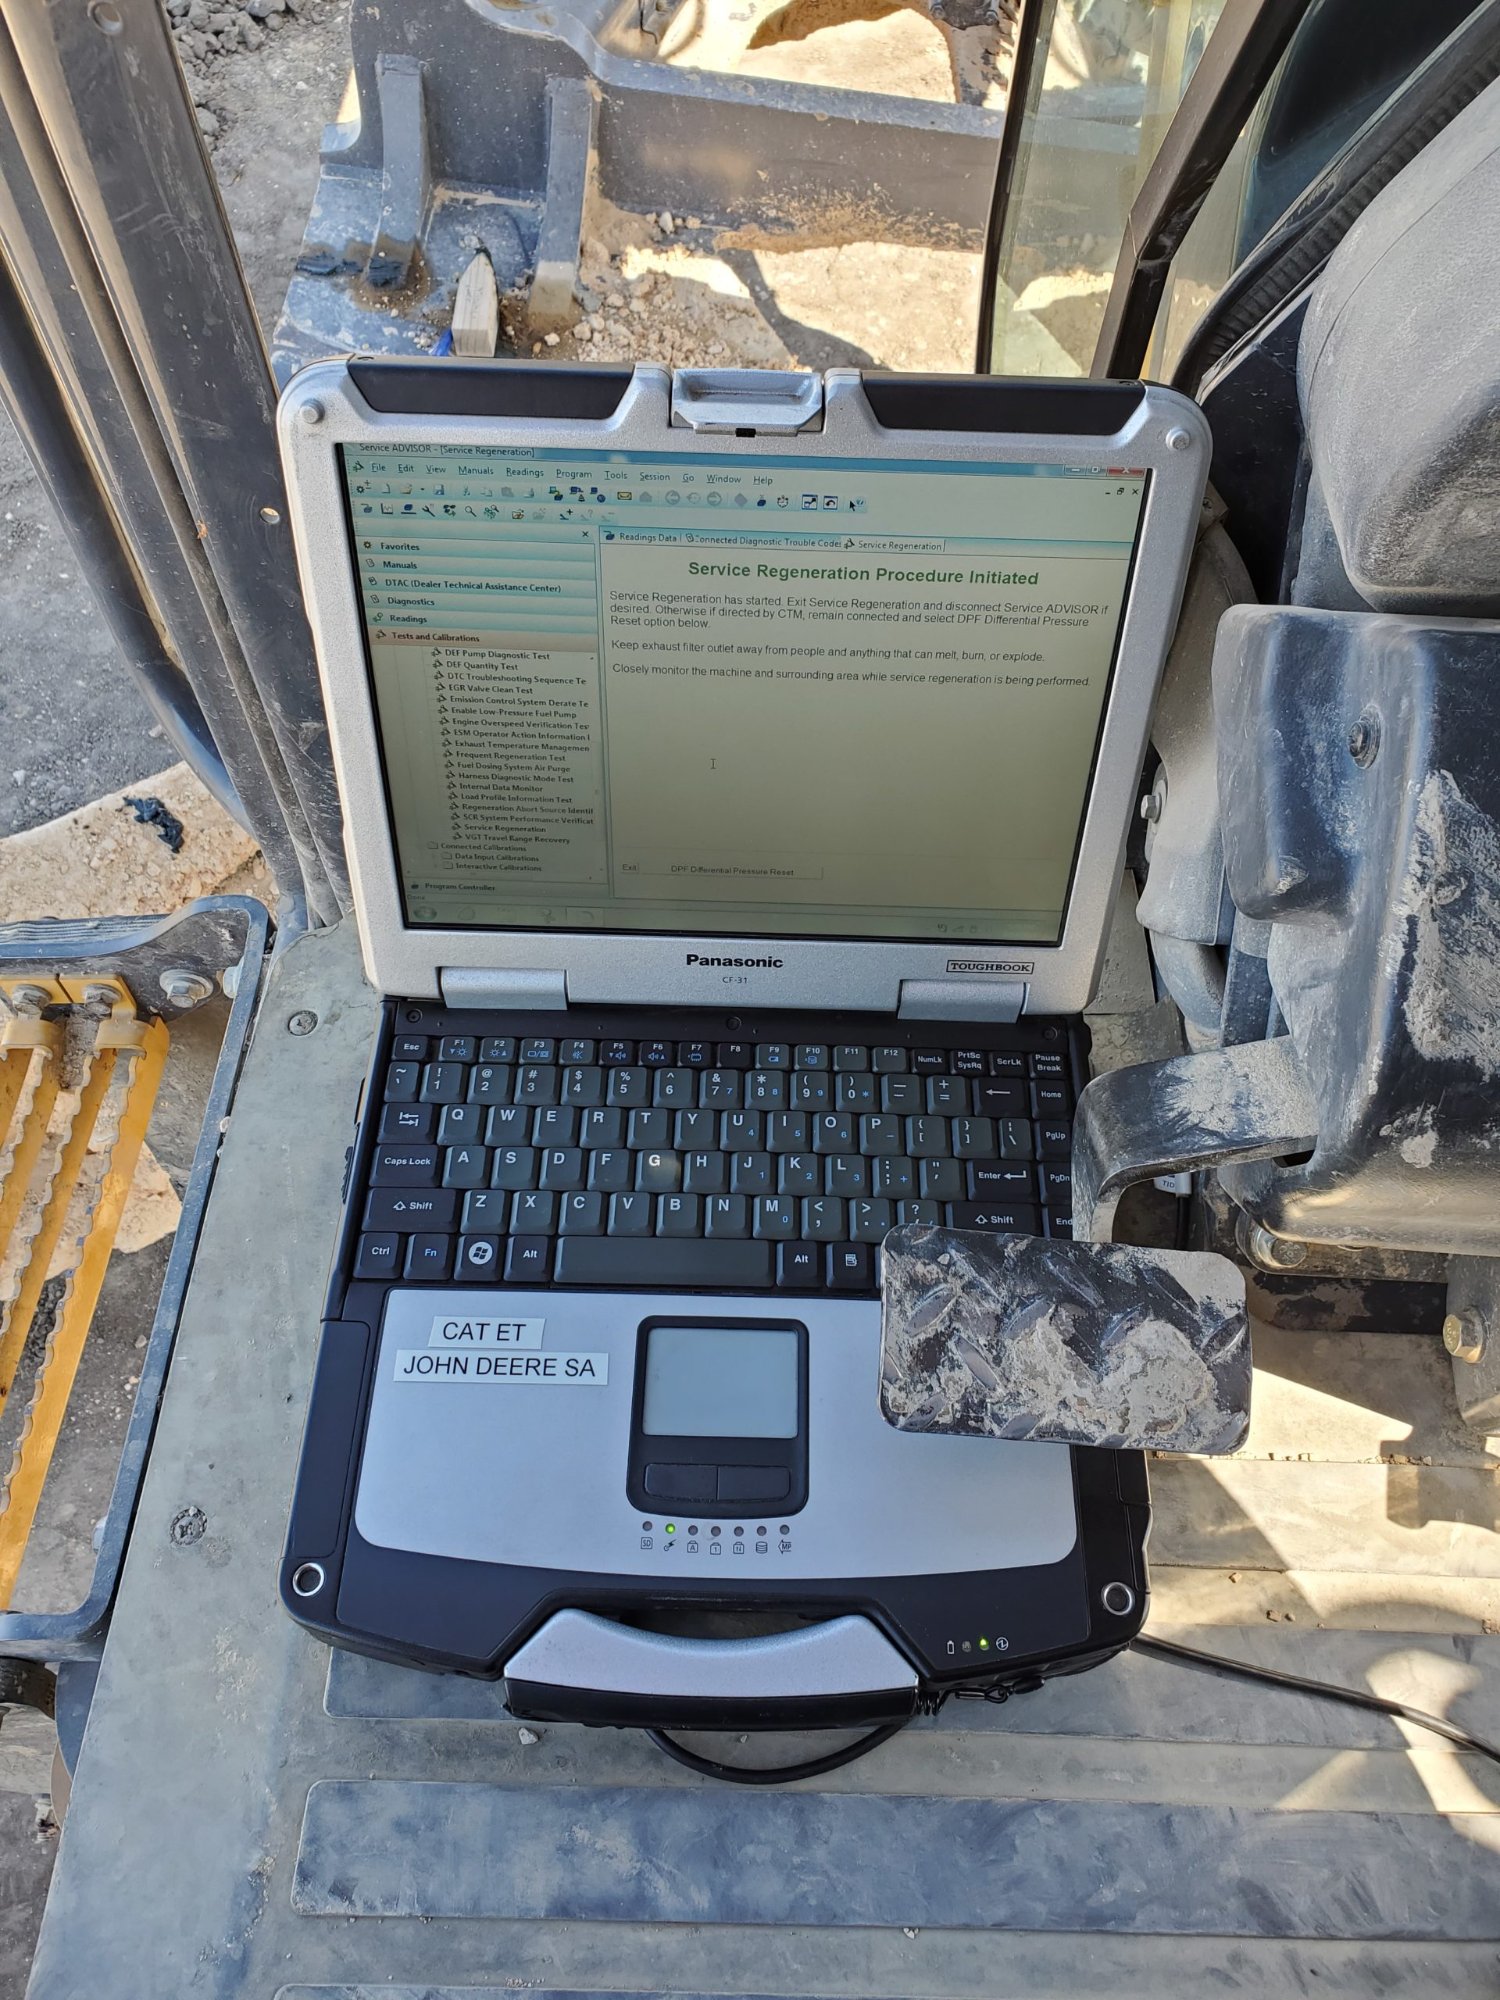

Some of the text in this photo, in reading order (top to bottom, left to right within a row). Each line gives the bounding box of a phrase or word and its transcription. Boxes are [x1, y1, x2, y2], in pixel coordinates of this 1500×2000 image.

[360, 444, 389, 452] Service
[392, 444, 431, 453] ADVISOR
[440, 445, 473, 455] [Service
[476, 446, 535, 458] Regeneration]
[372, 463, 386, 472] File
[398, 464, 414, 473] Edit
[426, 465, 446, 474] View
[459, 466, 493, 475] Manuals
[506, 467, 544, 478] Readings
[556, 469, 592, 480] Program
[604, 471, 628, 480] Tools
[640, 472, 670, 481] Session
[682, 473, 694, 482] Go
[707, 474, 741, 484] Window
[753, 475, 773, 486] Help
[620, 532, 677, 542] Readings Data
[381, 542, 420, 551] Favorites
[740, 537, 781, 546] Diagnostic
[785, 538, 815, 547] Trouble
[858, 541, 942, 552] Service Regeneration
[383, 560, 417, 570] Manuals
[689, 562, 1039, 585] Service Regeneration Procedure Initiated
[385, 579, 562, 593] DTAC (Dealer Technical Assistance Center)
[387, 596, 435, 607] Diagnostics
[610, 591, 1108, 615] Service Regeneration has started. Exit Service Regeneration and disconnect Service ADVISOR if
[390, 614, 427, 624] Readings
[610, 604, 1089, 627] desired. Otherwise if directed by CTM, remain connected and select DPF Differential Pressure
[610, 616, 710, 629] Reset option below.
[392, 632, 480, 642] Tests and Calibrations
[462, 650, 486, 659] Pump
[488, 651, 530, 660] Diagnostic
[612, 640, 1044, 663] Keep exhaust filter outlet away from people and anything that can melt, burn, or explode.
[464, 662, 498, 671] Quantity
[467, 673, 532, 684] Troubleshooting
[534, 676, 573, 685] Sequence
[613, 663, 1090, 687] Closely monitor the machine and surrounding area while service regeneration is being performed.
[686, 953, 784, 969] Panasonic
[950, 962, 1031, 972] TOUGHBOOK
[722, 976, 748, 985] CF-31
[403, 1042, 420, 1051] Esc
[731, 1045, 741, 1053] F8
[769, 1046, 780, 1054] F9
[884, 1049, 898, 1057] F12
[957, 1051, 981, 1060] PrtSc
[918, 1055, 943, 1064] NumLk
[997, 1058, 1022, 1066] ScrLk
[1035, 1054, 1060, 1062] Pause
[957, 1061, 982, 1070] SysRq
[1037, 1063, 1061, 1072] Break
[1041, 1091, 1061, 1099] Home
[1046, 1132, 1066, 1141] PgUp
[384, 1157, 431, 1167] Caps Lock
[978, 1171, 1001, 1180] Enter
[1050, 1173, 1070, 1182] PgDn
[409, 1202, 433, 1210] Shift
[990, 1214, 1014, 1224] Shift
[372, 1247, 390, 1256] Ctrl
[425, 1248, 437, 1257] Fn
[523, 1250, 538, 1258] Alt
[794, 1254, 809, 1264] Alt
[443, 1322, 527, 1342] CAT ET
[404, 1355, 596, 1377] JOHN DEERE SA
